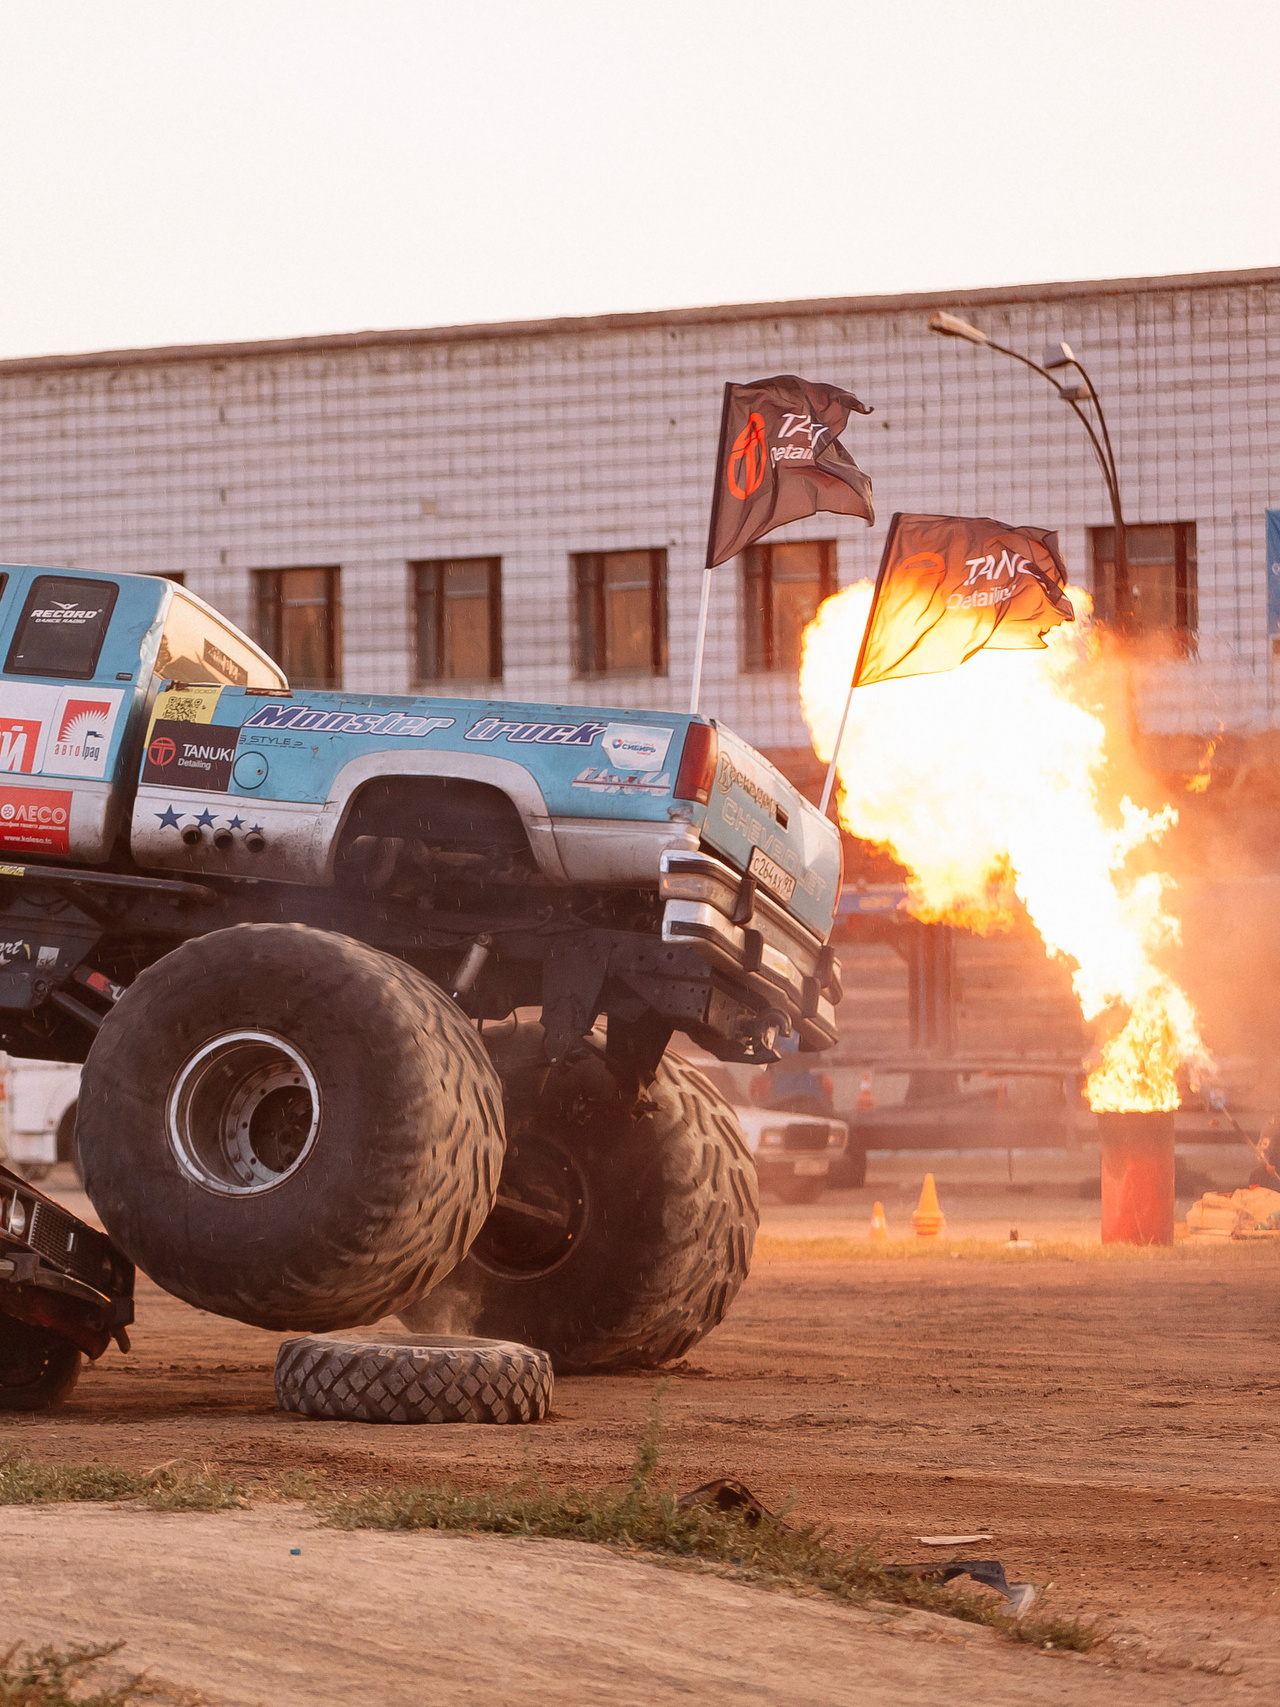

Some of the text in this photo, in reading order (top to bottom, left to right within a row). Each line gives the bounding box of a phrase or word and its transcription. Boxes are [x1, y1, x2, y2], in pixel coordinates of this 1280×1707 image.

[30, 609, 98, 619] RECORD
[242, 703, 608, 747] Monster truck
[250, 735, 293, 746] STYLE
[182, 743, 235, 762] TANUKI
[622, 743, 656, 753] СИБИРЬ
[178, 757, 212, 770] Detailing
[721, 797, 827, 901] CHEVROLET
